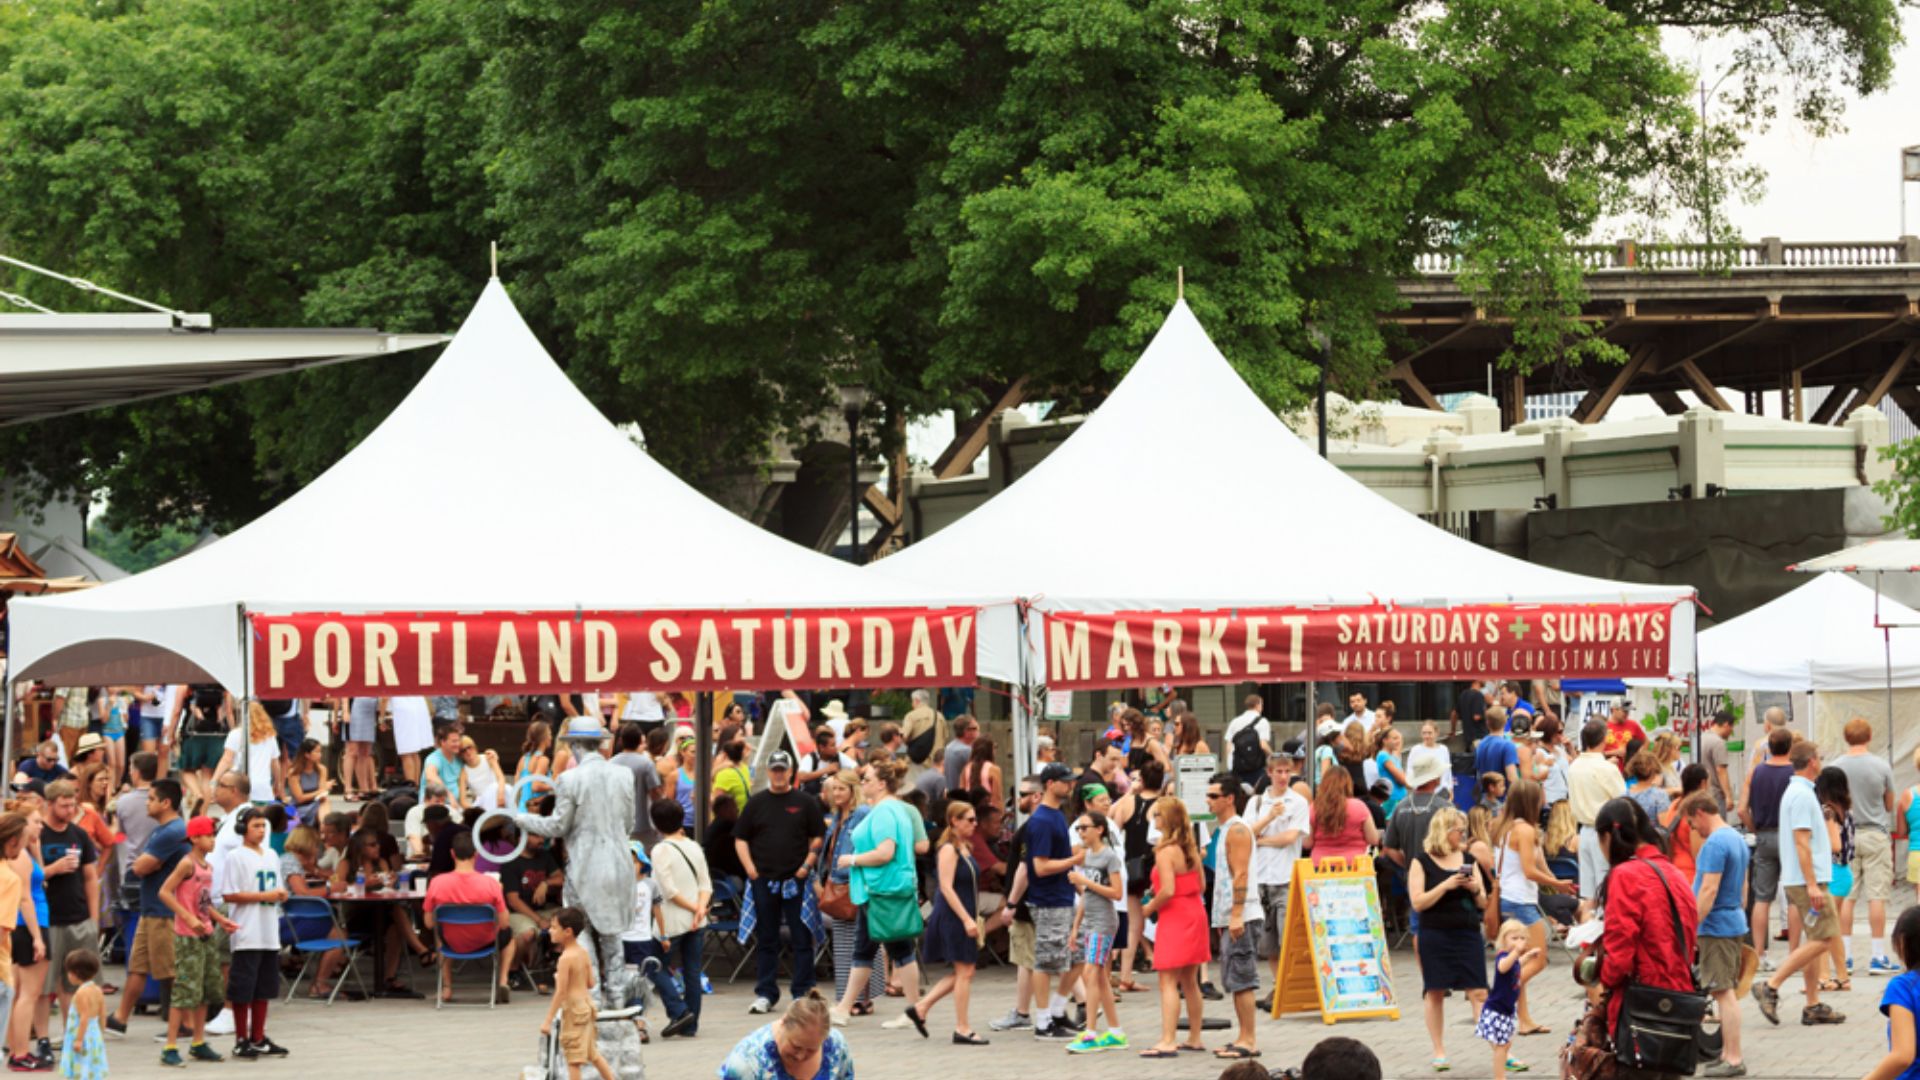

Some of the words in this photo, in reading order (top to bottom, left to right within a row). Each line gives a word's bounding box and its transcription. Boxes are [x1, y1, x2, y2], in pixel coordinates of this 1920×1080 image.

[269, 620, 618, 688] PORTLAND
[649, 616, 972, 682] SATURDAY
[1050, 615, 1308, 681] MARKET
[1337, 612, 1500, 644] SATURDAYS
[1541, 612, 1665, 643] SUNDAYS
[1337, 650, 1400, 672] MARCH
[1415, 650, 1499, 671] THROUGH
[1512, 648, 1618, 671] CHRISTMAS
[1632, 648, 1661, 669] EVE
